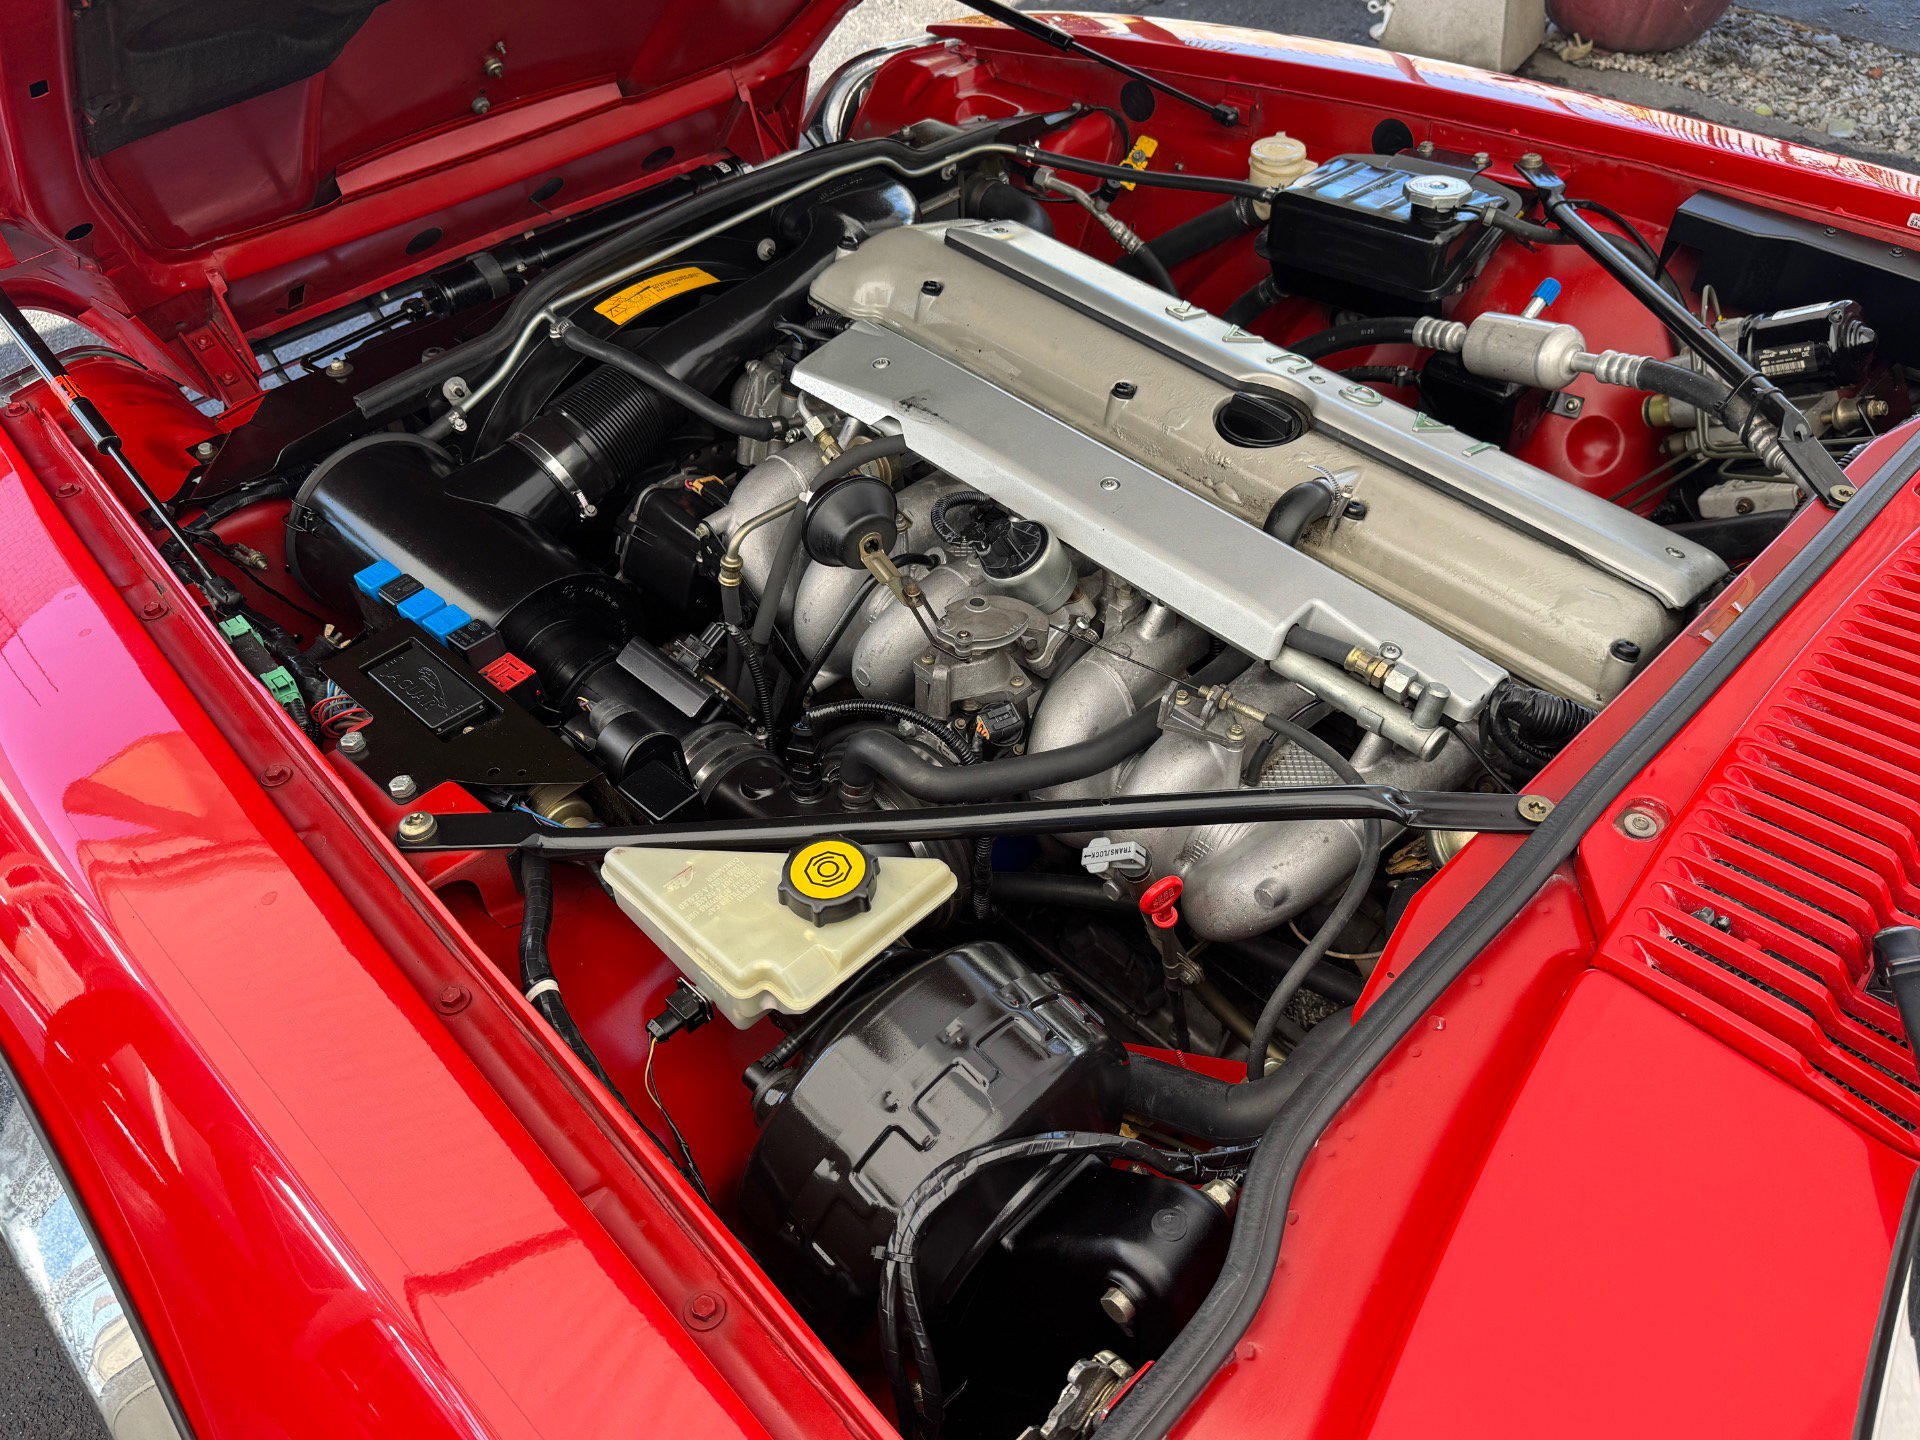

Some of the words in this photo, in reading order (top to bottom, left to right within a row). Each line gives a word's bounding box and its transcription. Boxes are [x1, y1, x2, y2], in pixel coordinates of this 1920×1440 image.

[1165, 300, 1499, 457] JAGUAR
[380, 671, 437, 711] JAGUAR
[1091, 846, 1132, 858] TRANS/LOCK
